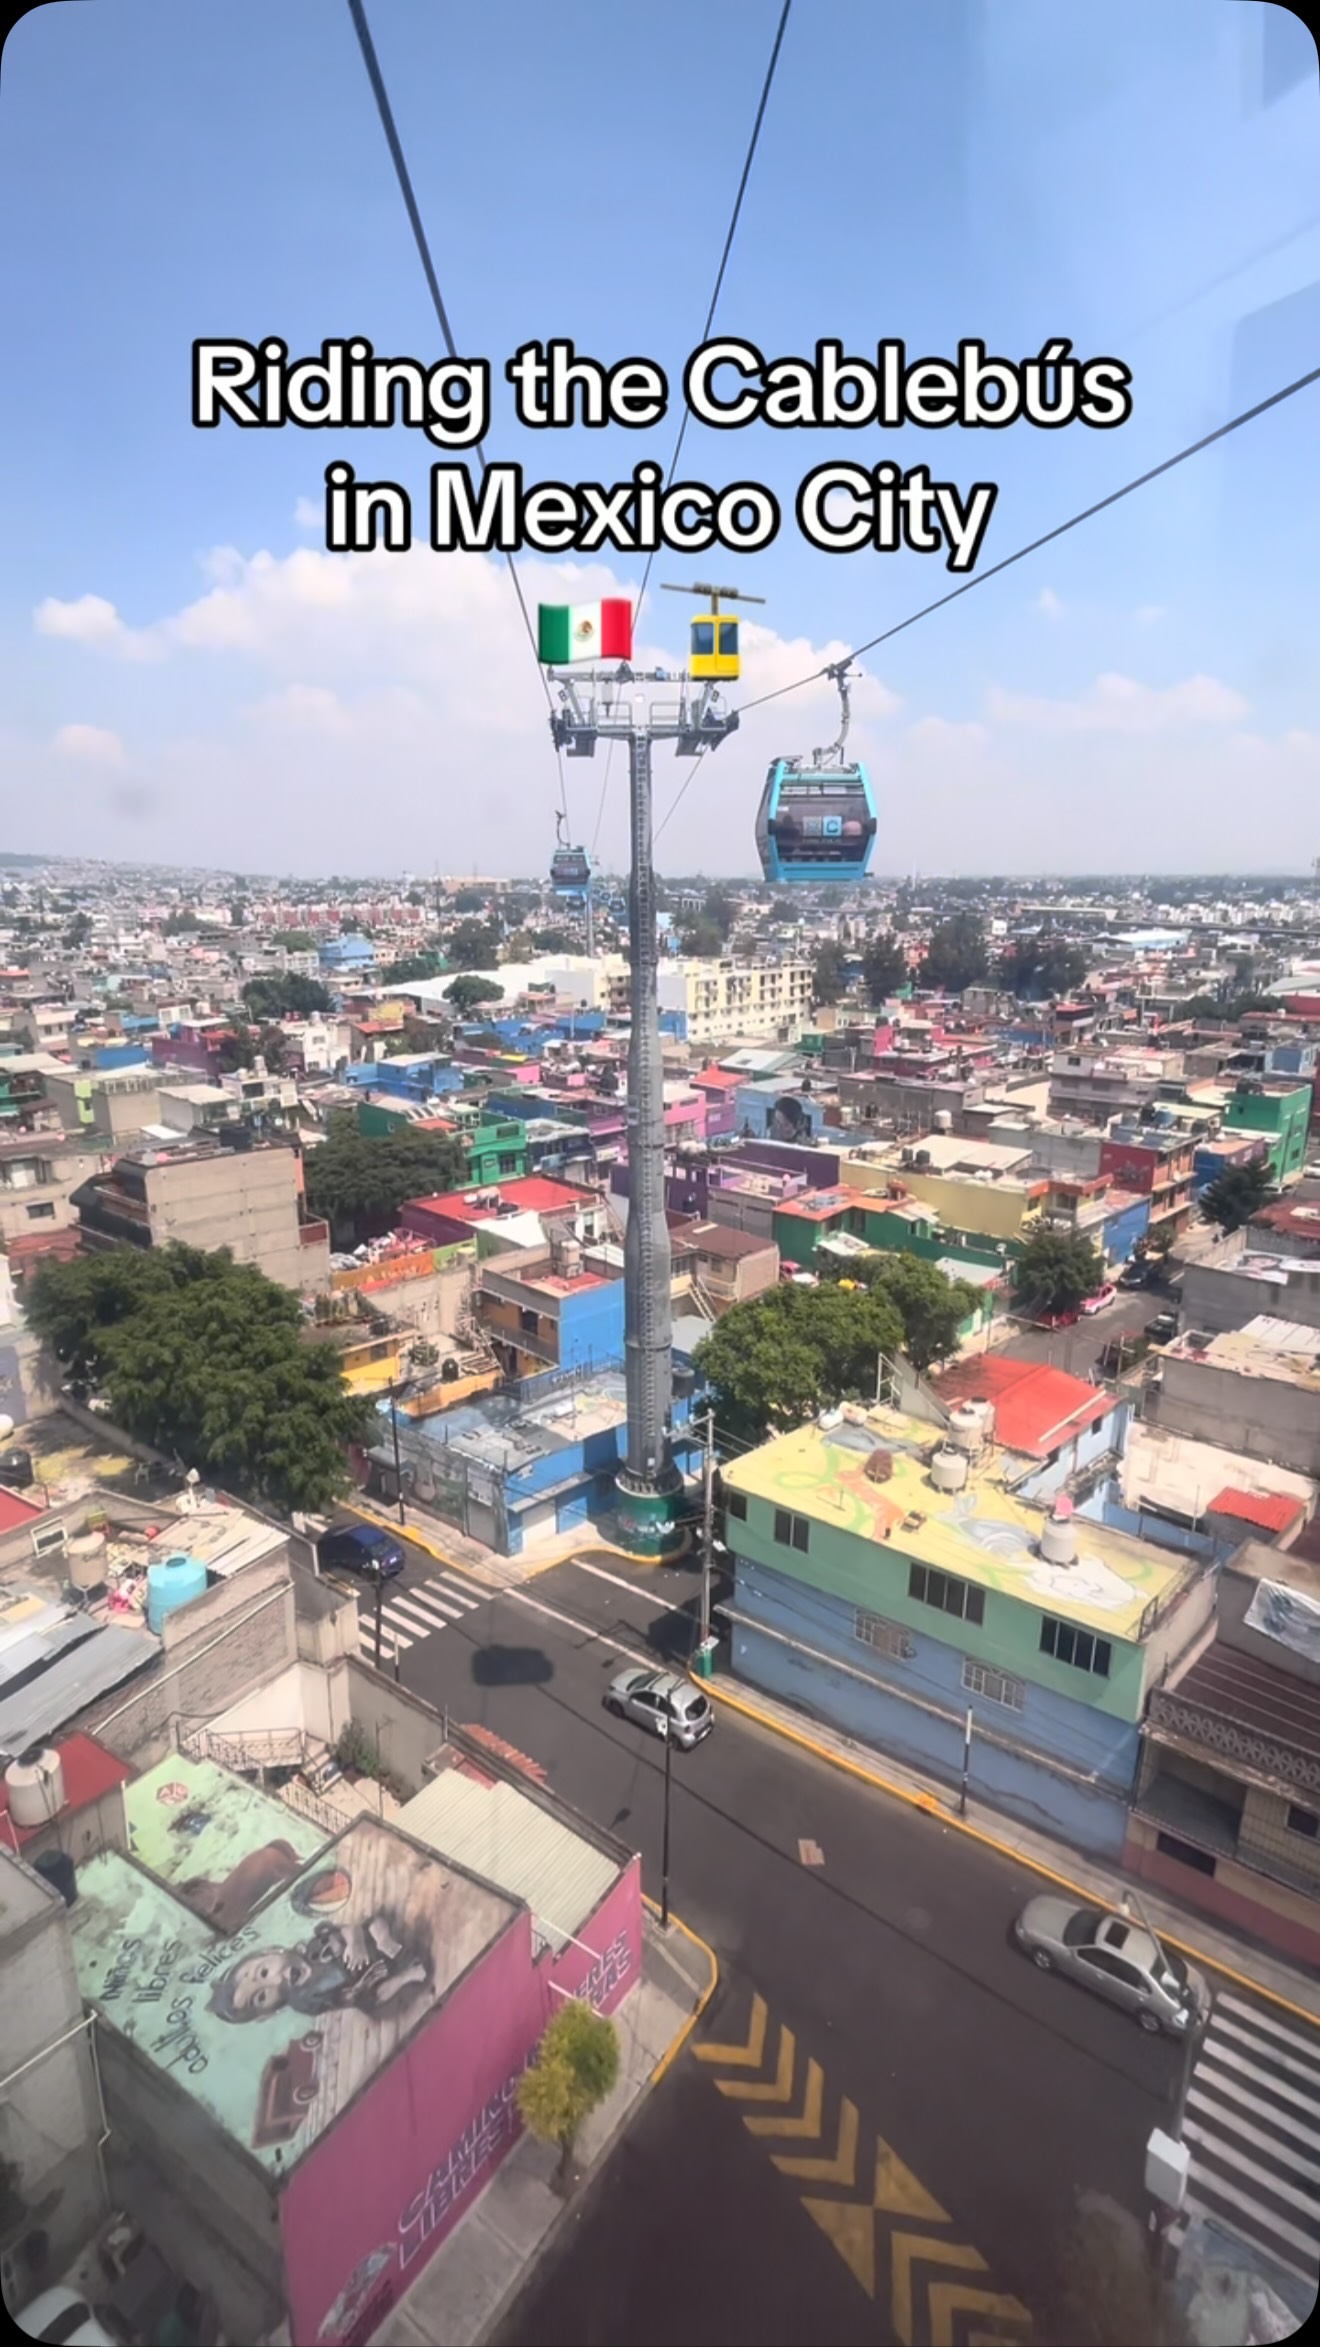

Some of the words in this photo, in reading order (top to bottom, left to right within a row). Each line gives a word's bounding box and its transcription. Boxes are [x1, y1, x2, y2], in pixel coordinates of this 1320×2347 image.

[131, 1939, 183, 2003] libres
[179, 1926, 261, 1984] felices
[150, 1995, 209, 2074] adultos
